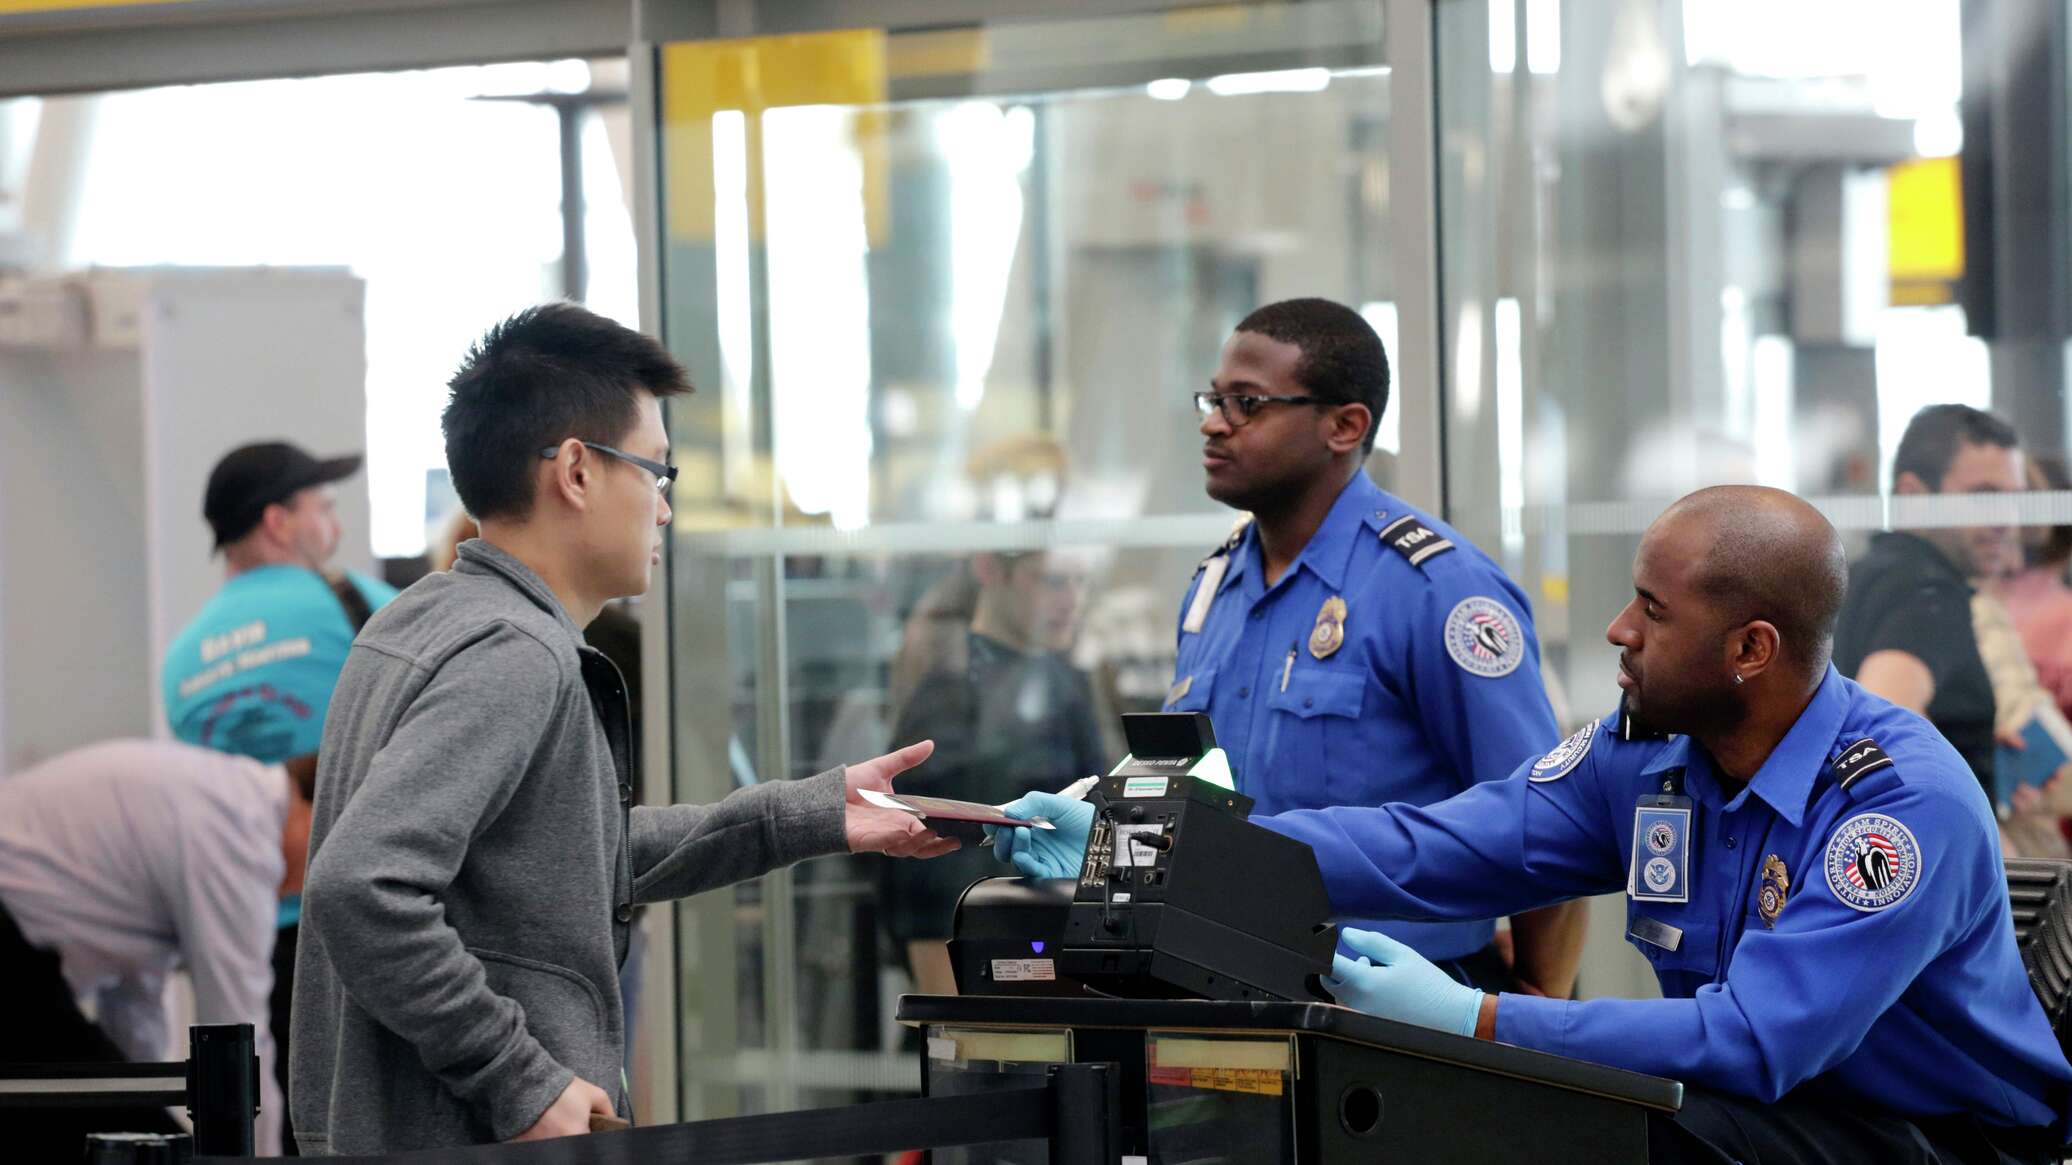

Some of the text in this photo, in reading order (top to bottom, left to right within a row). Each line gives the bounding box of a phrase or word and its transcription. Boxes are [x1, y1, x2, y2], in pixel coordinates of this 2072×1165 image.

[1394, 527, 1434, 548] TSA
[1836, 747, 1878, 769] TSA
[1841, 819, 1909, 843] TEAM SPIRIT
[1829, 845, 1860, 904] INTEGRITY
[1873, 852, 1915, 906] INNOVATION
